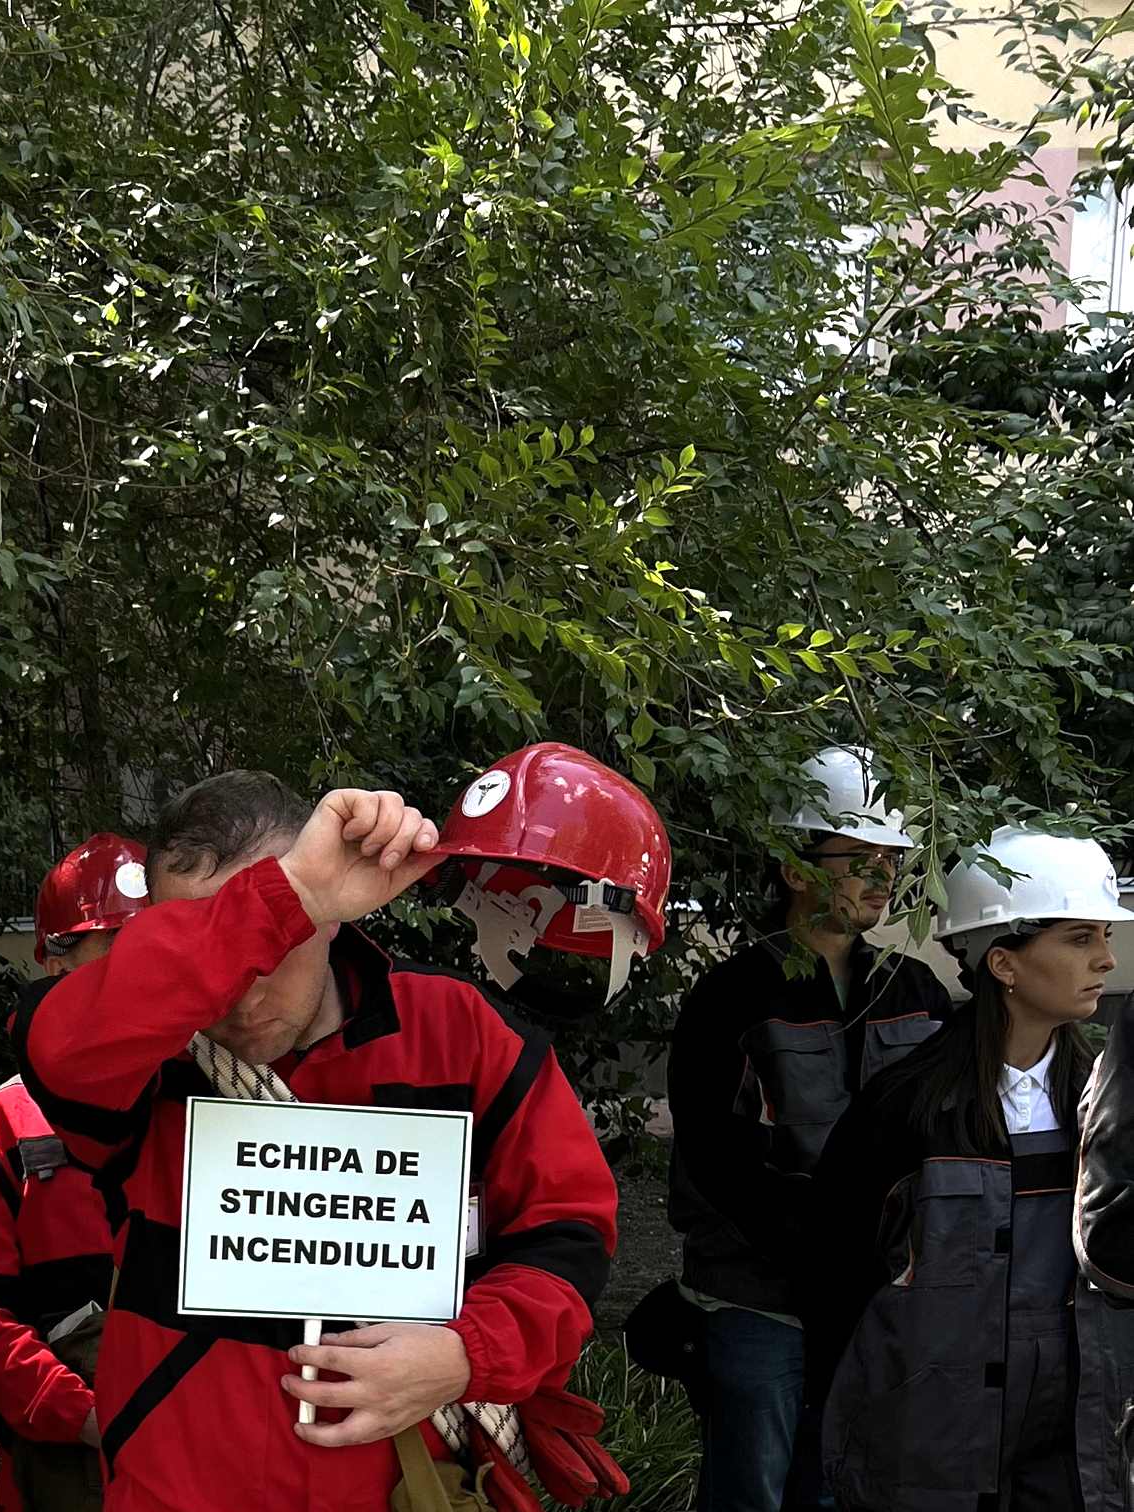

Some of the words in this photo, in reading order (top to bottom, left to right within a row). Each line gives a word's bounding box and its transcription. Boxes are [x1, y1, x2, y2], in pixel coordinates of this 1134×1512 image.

[236, 1141, 363, 1173] ECHIPA
[375, 1150, 419, 1176] DE
[220, 1188, 395, 1221] STINGERE
[406, 1199, 430, 1223] A
[209, 1235, 435, 1270] INCENDIULUI
